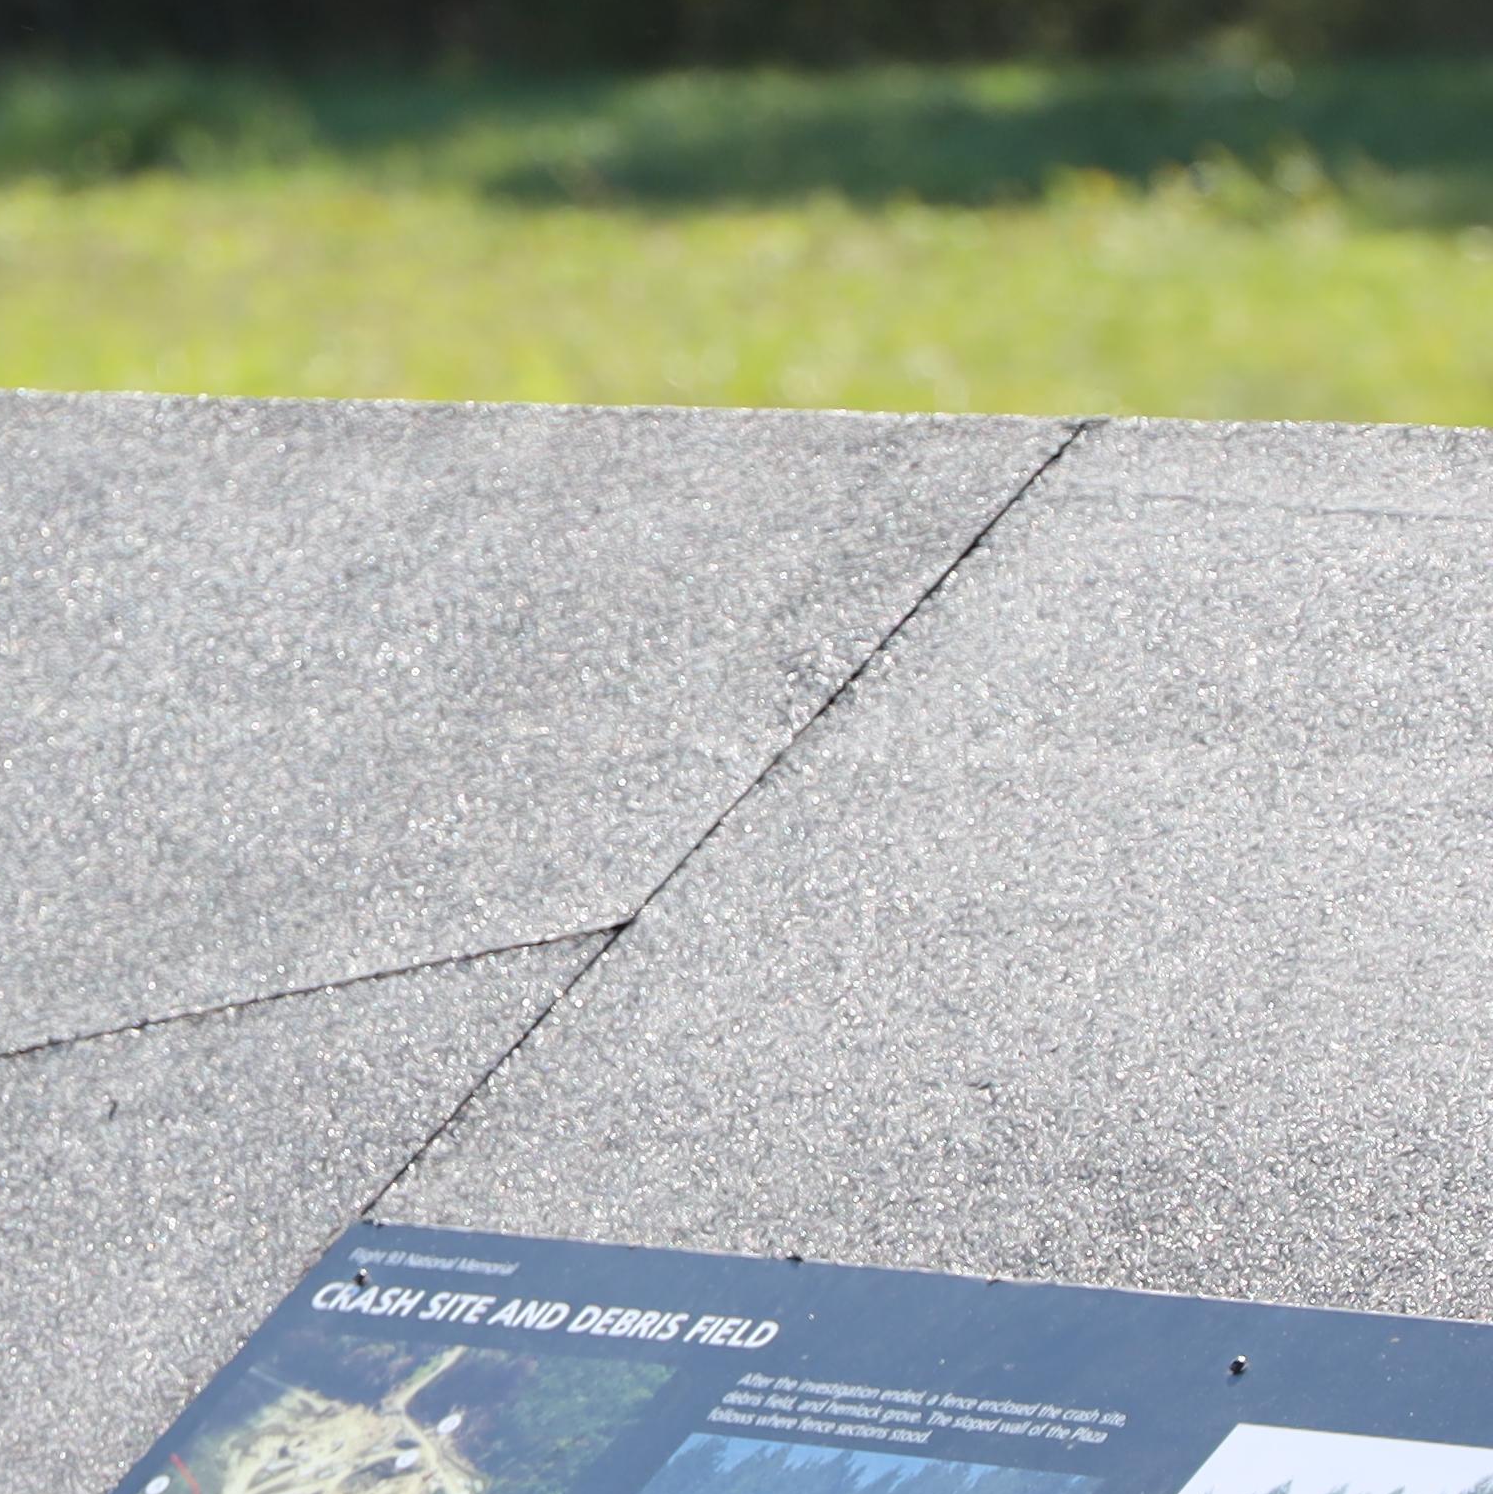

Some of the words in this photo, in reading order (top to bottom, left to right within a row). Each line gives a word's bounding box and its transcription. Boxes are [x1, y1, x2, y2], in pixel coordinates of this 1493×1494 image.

[403, 1253, 462, 1270] National
[456, 1257, 520, 1275] Memorial
[313, 1282, 425, 1317] CRASH
[418, 1292, 497, 1324] SITE
[487, 1299, 570, 1330] AND
[566, 1305, 690, 1341] DEBRIS
[683, 1315, 779, 1349] FIELD
[706, 1406, 756, 1425] follows
[755, 1413, 798, 1429] where
[797, 1416, 837, 1433] fence
[835, 1423, 889, 1440] sections
[888, 1428, 931, 1444] stood.
[722, 1390, 764, 1407] debris
[764, 1393, 798, 1411] field,
[797, 1399, 829, 1413] and
[824, 1401, 883, 1419] hemlock
[879, 1409, 922, 1424] grove.
[926, 1410, 953, 1427] The
[951, 1414, 1002, 1432] sloped
[998, 1420, 1032, 1435] wall
[1028, 1422, 1047, 1437] of
[1045, 1424, 1071, 1439] the
[1070, 1427, 1108, 1444] Plaza
[737, 1372, 775, 1388] After
[773, 1376, 798, 1391] the
[797, 1378, 881, 1400] investigation
[880, 1389, 927, 1405] ended,
[926, 1394, 939, 1406] a
[940, 1392, 978, 1410] fence
[977, 1399, 1041, 1417] enclosed
[1038, 1403, 1063, 1419] the
[1062, 1408, 1099, 1424] crash
[1098, 1411, 1127, 1427] site,
